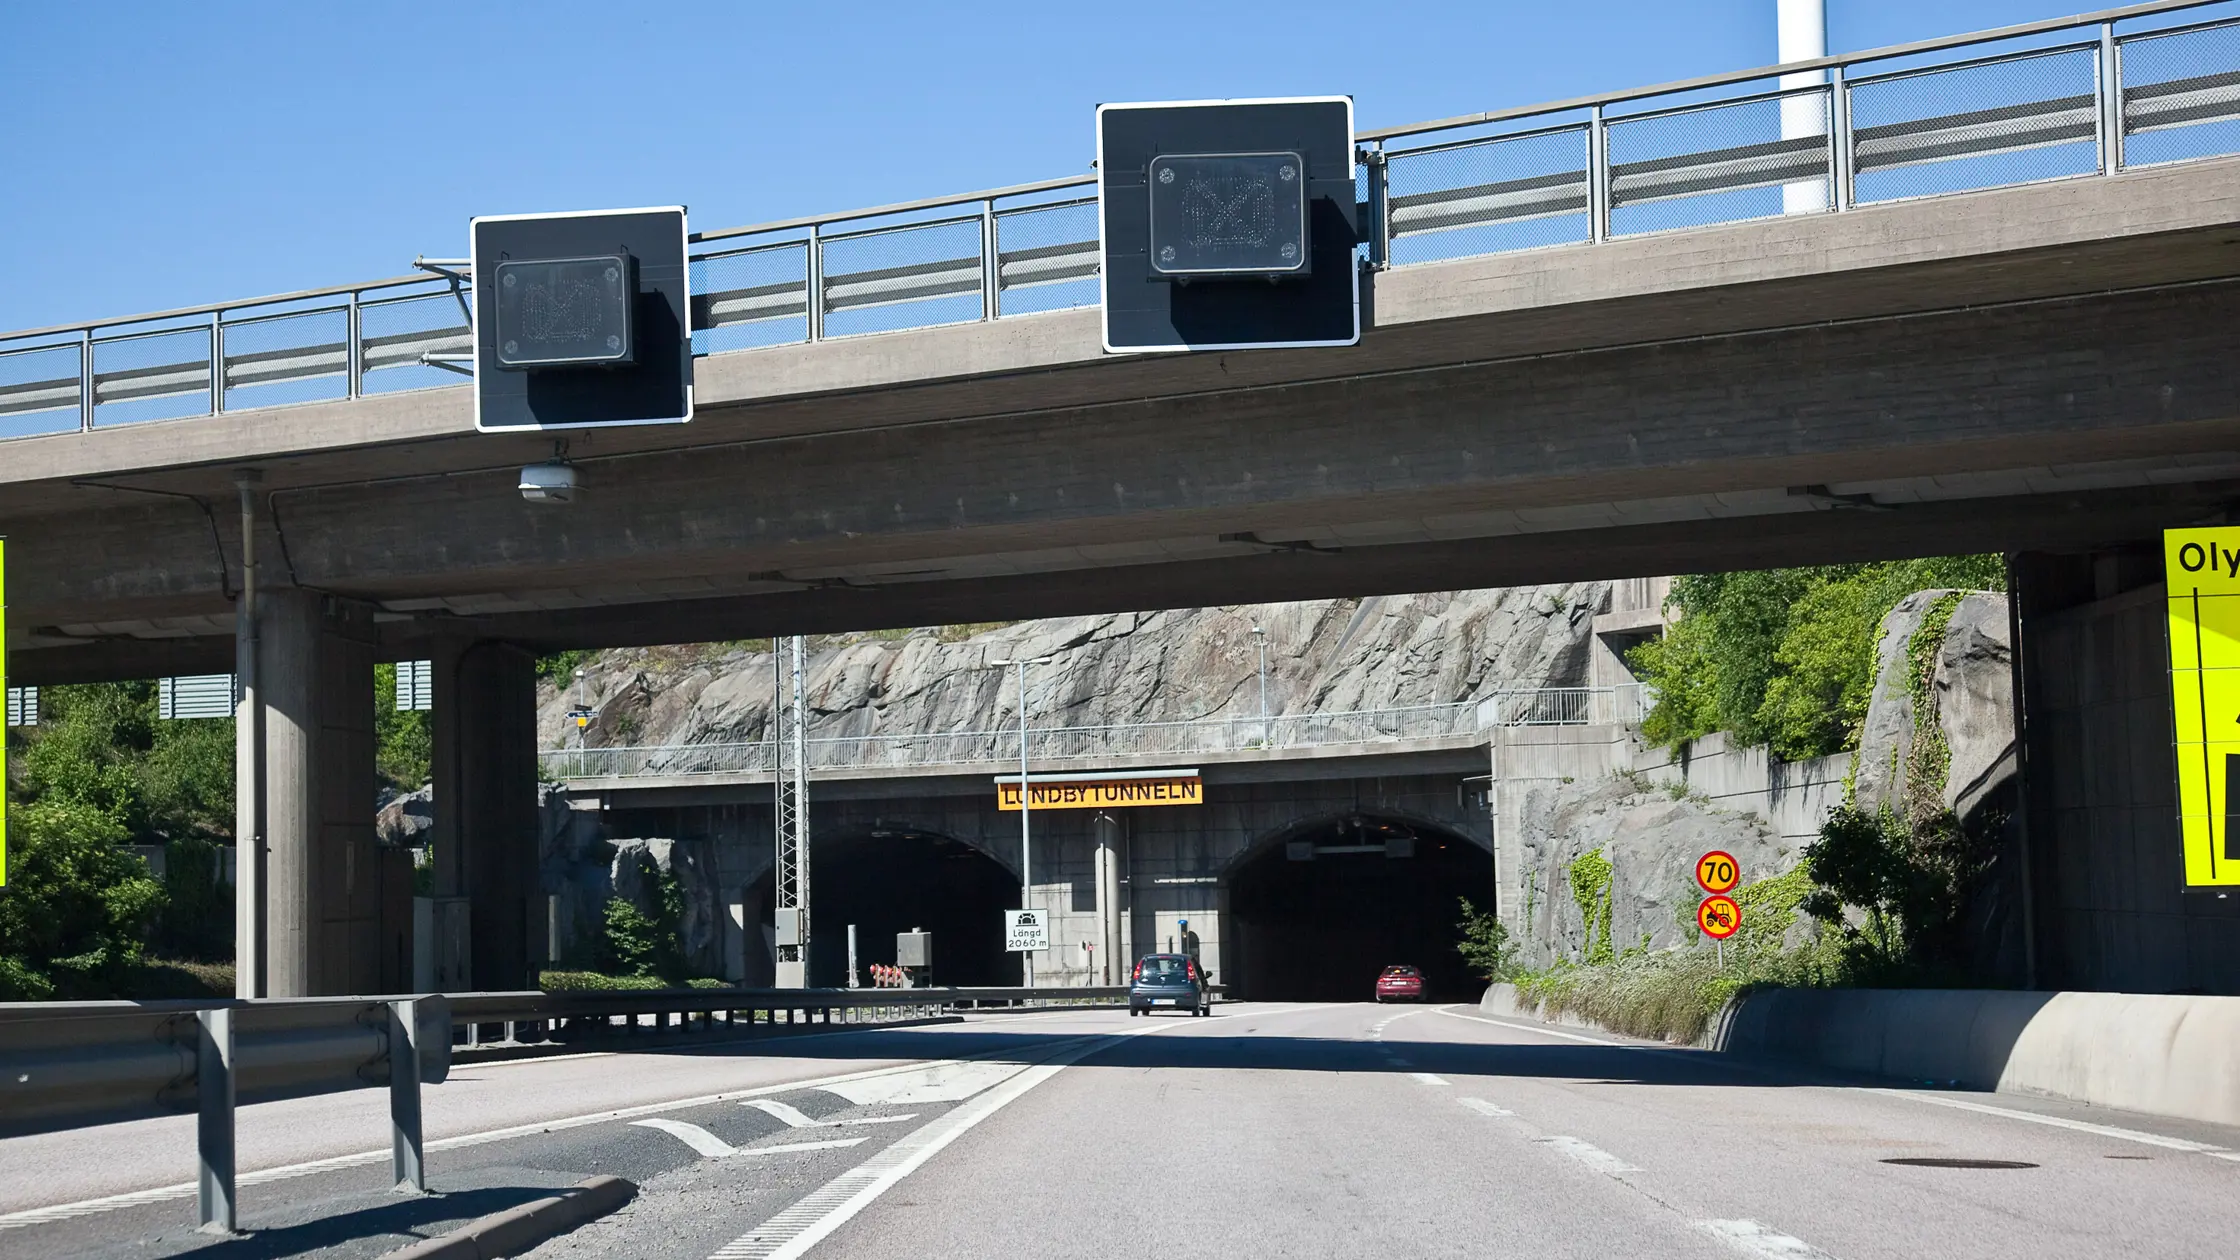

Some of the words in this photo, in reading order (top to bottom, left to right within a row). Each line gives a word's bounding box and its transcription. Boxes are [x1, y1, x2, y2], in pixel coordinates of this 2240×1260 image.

[1705, 862, 1732, 883] 70
[1013, 929, 1041, 938] Längd
[1008, 939, 1036, 947] 2060
